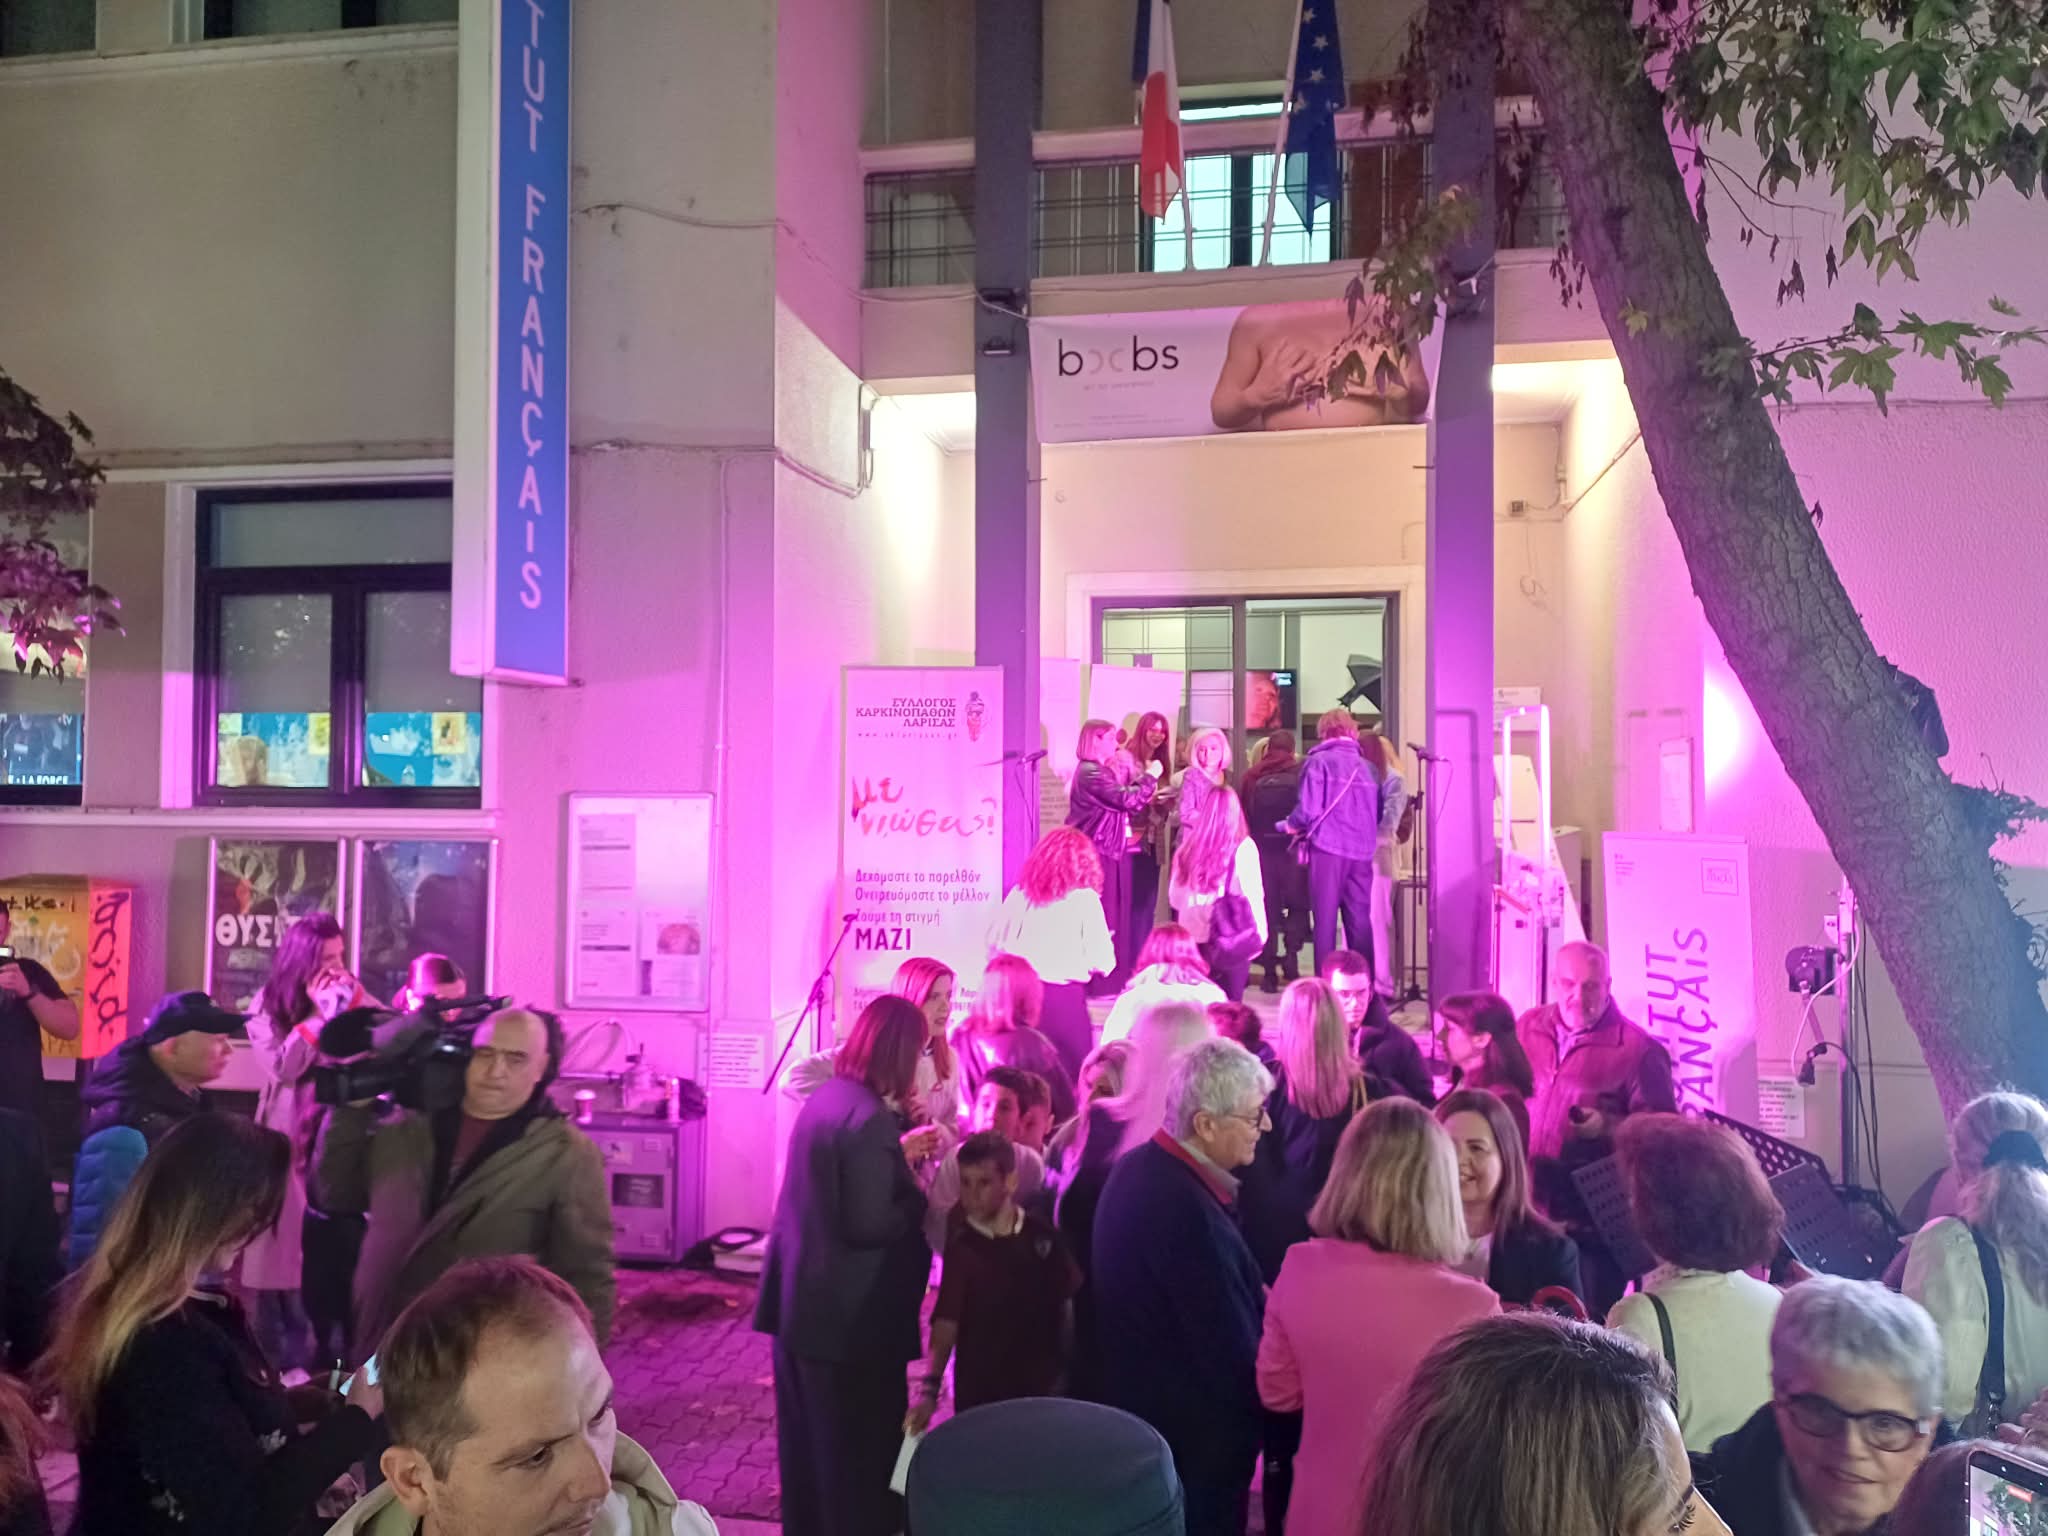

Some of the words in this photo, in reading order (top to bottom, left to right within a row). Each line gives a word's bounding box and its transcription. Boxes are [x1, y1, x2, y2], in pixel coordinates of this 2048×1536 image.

[517, 183, 546, 609] FRANÇAIS
[892, 698, 957, 708] ΣΥΛΛΟΓΟΣ
[856, 708, 957, 718] ΚΑΡΚΙΝΟΠΑΘΩΝ
[903, 718, 956, 728] ΛΑΡΙΣΑΣ
[914, 872, 925, 883] το
[928, 869, 981, 886] παρελθόν
[855, 887, 935, 904] Ονειρευόμαστε
[938, 890, 950, 901] το
[952, 888, 990, 904] μέλλον
[905, 909, 940, 927] στιγμή
[856, 927, 911, 950] ΜΑΖΙ
